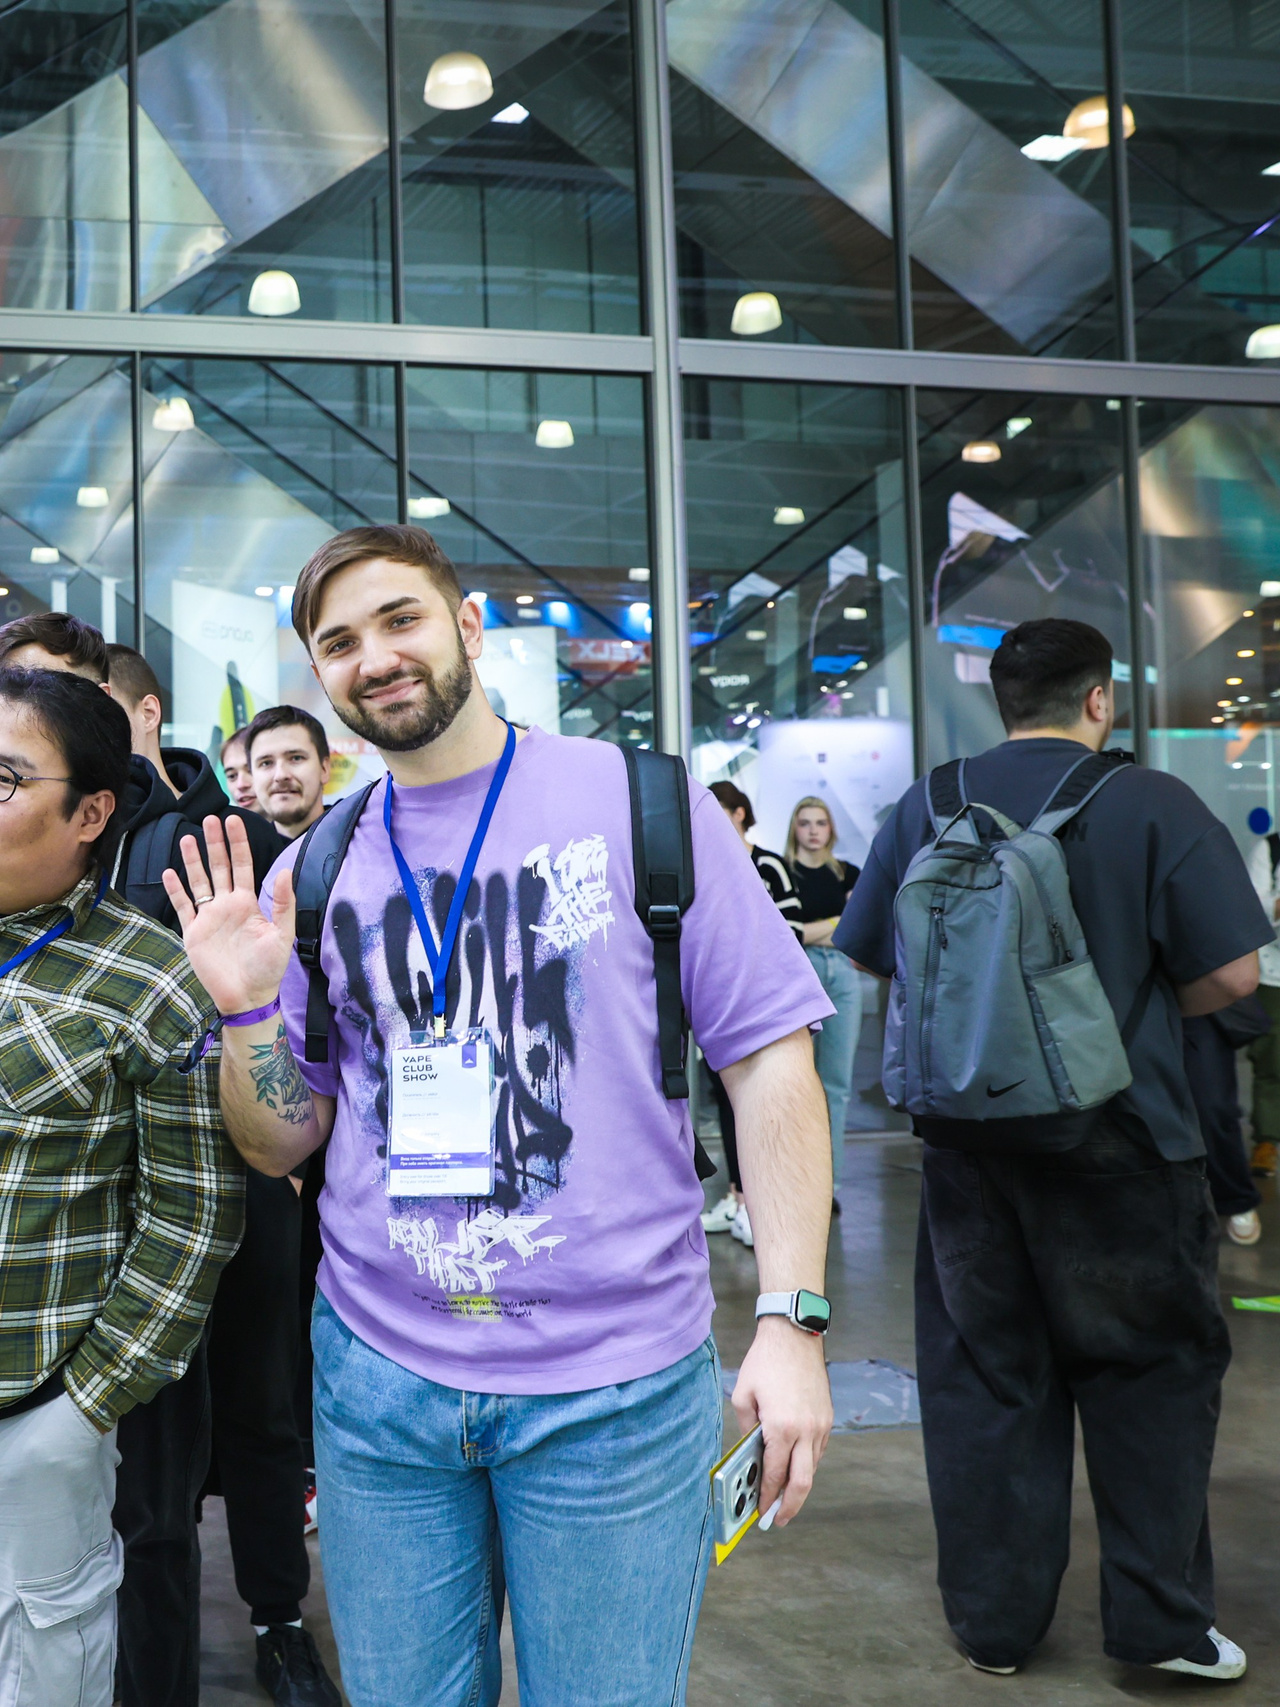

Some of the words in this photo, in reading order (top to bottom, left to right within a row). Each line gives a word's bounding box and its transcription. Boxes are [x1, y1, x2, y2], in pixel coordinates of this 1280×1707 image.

[402, 1055, 432, 1063] VAPE
[402, 1064, 433, 1073] CLUB
[403, 1073, 438, 1082] SHOW
